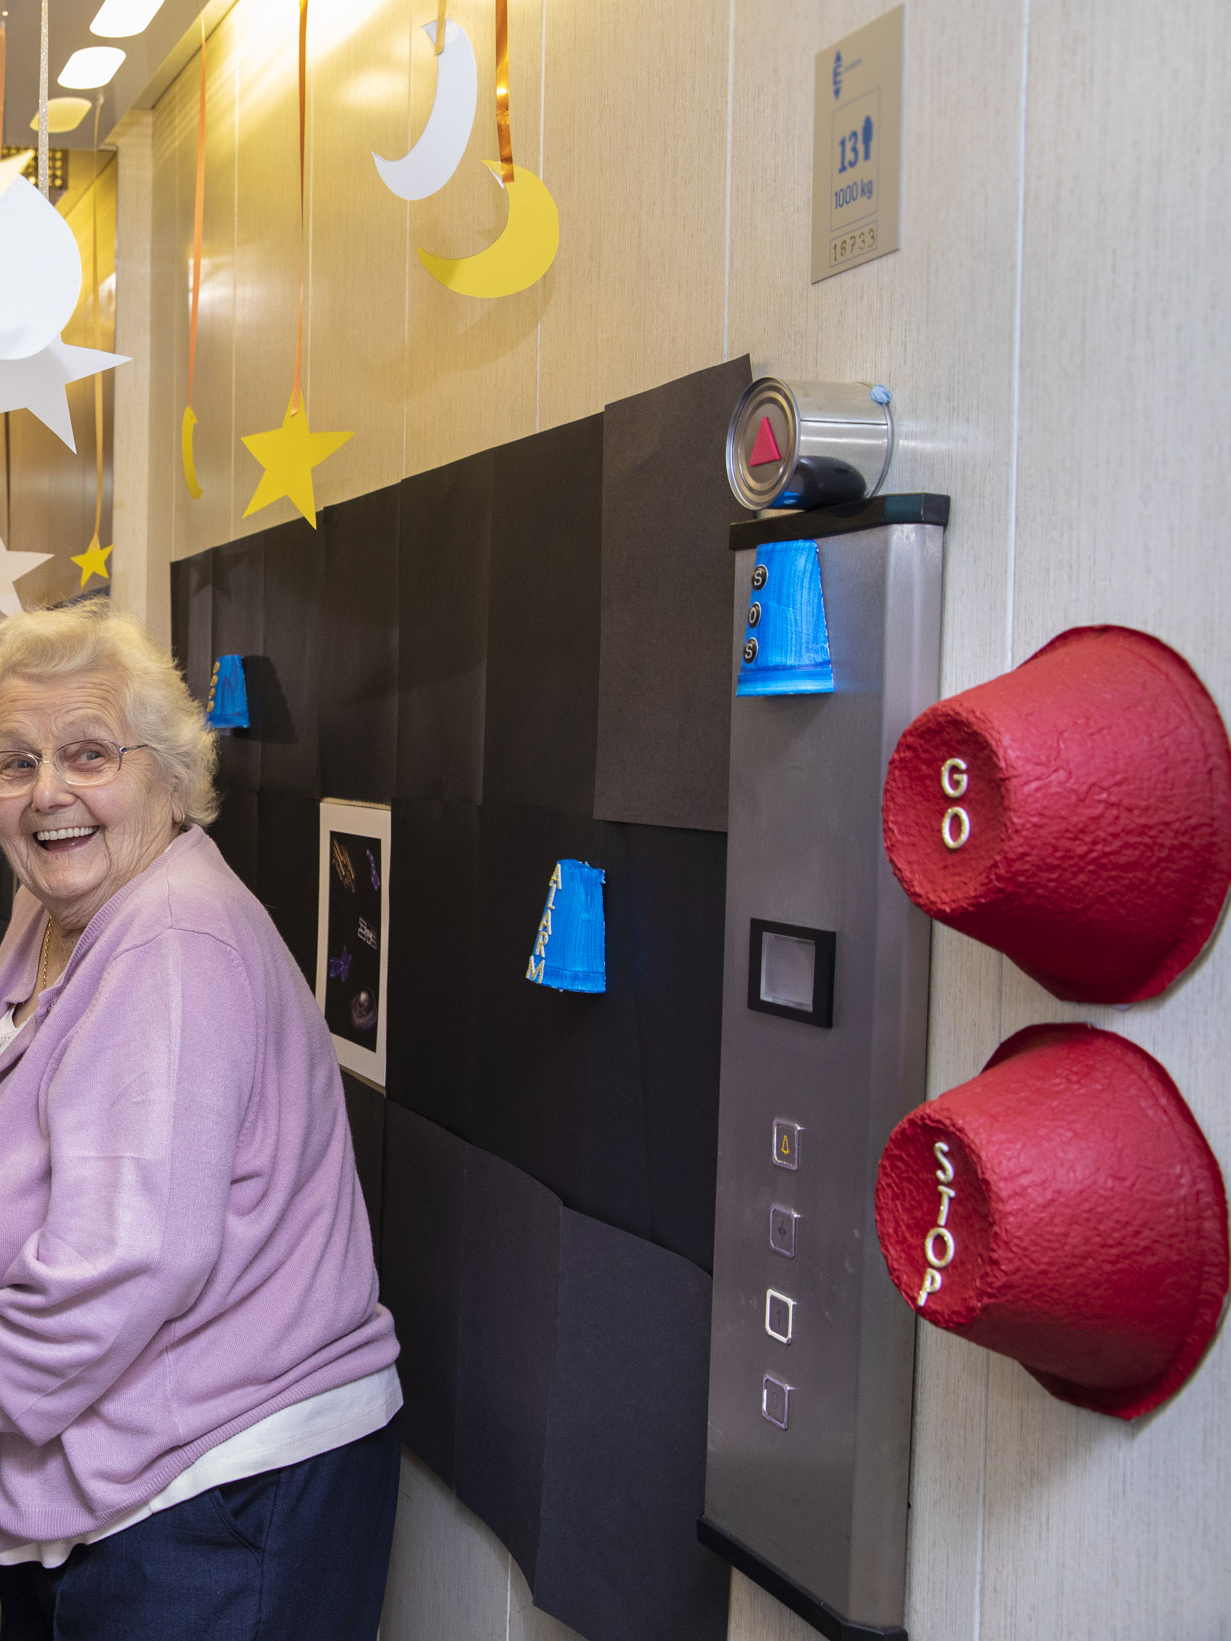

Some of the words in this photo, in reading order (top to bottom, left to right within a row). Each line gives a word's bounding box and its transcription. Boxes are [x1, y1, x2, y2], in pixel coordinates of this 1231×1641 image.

[834, 182, 859, 209] 1000
[860, 179, 874, 200] kg
[838, 130, 859, 174] 13
[744, 566, 767, 661] SOS
[941, 758, 970, 849] GO
[526, 863, 562, 984] ALARM
[917, 1142, 956, 1307] STOP
